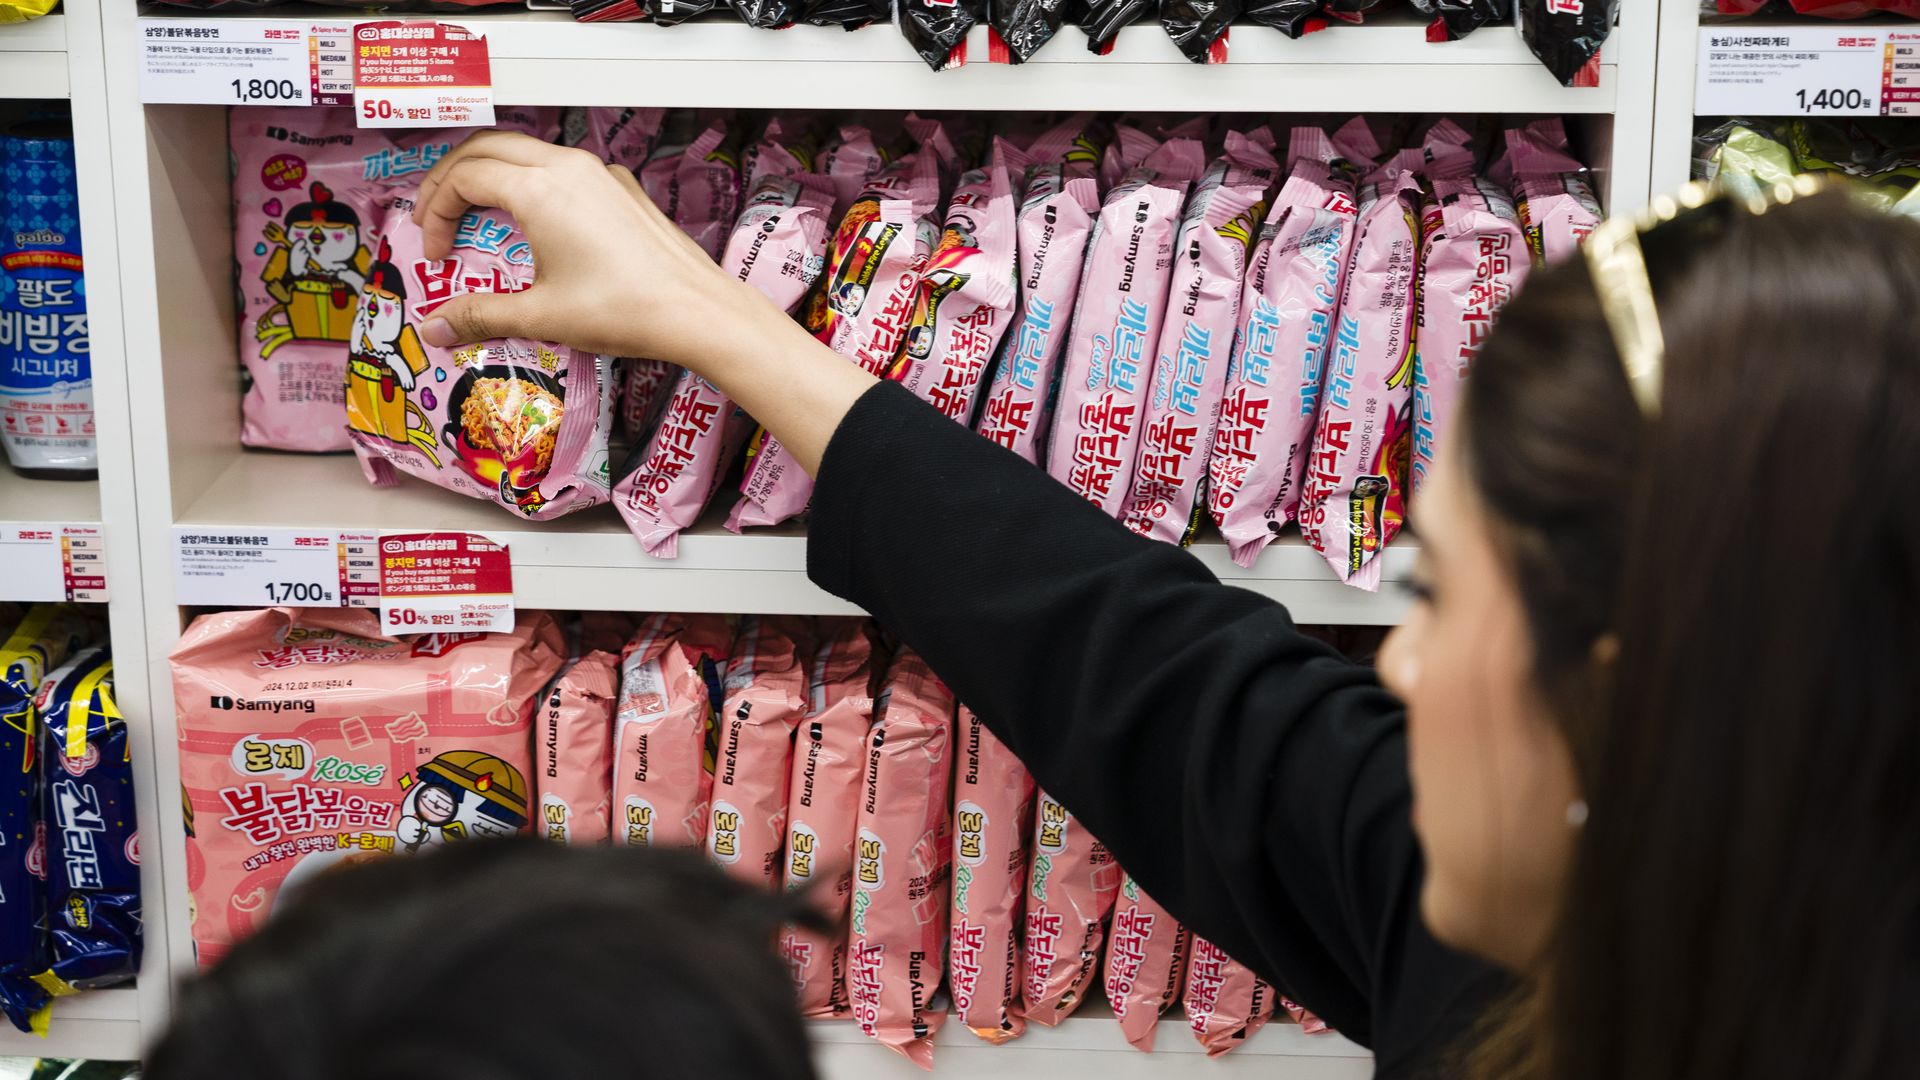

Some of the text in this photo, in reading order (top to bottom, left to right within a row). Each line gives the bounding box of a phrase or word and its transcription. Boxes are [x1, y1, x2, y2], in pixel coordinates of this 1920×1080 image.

[146, 27, 219, 38] 삼양)불닭볶음탕면
[360, 46, 459, 57] 봉지면 5개 이상 구매 시
[1711, 37, 1790, 47] 농심)사천짜파게티
[380, 58, 393, 66] buy
[364, 100, 431, 119] 50% 할인
[290, 129, 353, 147] Samyang
[16, 230, 64, 248] paldo
[859, 227, 895, 285] Buldak Fire Level
[860, 241, 871, 253] 3
[1027, 224, 1055, 290] Samyang
[1118, 225, 1143, 292] Samyang
[1400, 264, 1410, 273] 중
[1417, 244, 1433, 328] Samyang
[16, 278, 74, 307] 팔도
[1011, 295, 1054, 388] 까르보
[1088, 334, 1110, 390] Carbo
[1108, 297, 1147, 392] 까르보
[1329, 314, 1359, 408] 까르보
[1385, 329, 1399, 359] 0.42%,
[12, 358, 78, 378] 시그니처
[1169, 321, 1212, 415] 까르보
[1365, 419, 1374, 434] 130
[629, 387, 720, 514] 불닭볶음면
[532, 492, 540, 502] 3
[1265, 443, 1298, 518] Samyang
[180, 535, 269, 546] 삼양)까르보불닭볶음면
[385, 557, 480, 568] 봉지면 5개 이상 구매 시
[1352, 544, 1360, 571] Level
[1363, 536, 1376, 547] 3
[389, 609, 454, 625] 50% 할인
[236, 698, 316, 713] Samyang
[244, 740, 304, 772] 로제
[546, 710, 560, 778] Samyang
[722, 720, 742, 786] Samyang
[966, 717, 981, 785] Samyang
[313, 756, 387, 785] Rosé
[800, 742, 822, 808] Samyang
[865, 749, 881, 815] Samyang
[53, 780, 106, 889] 진라면
[222, 784, 394, 842] 불닭볶음면
[627, 804, 651, 847] 로제
[713, 809, 737, 856] 로제
[959, 811, 983, 858] 로제
[1040, 801, 1065, 847] 로제
[244, 833, 394, 872] 내가 찾던 완벽한 K-로제!
[791, 831, 814, 878] 로제
[860, 837, 881, 883] 로제
[910, 951, 925, 1026] Samyang
